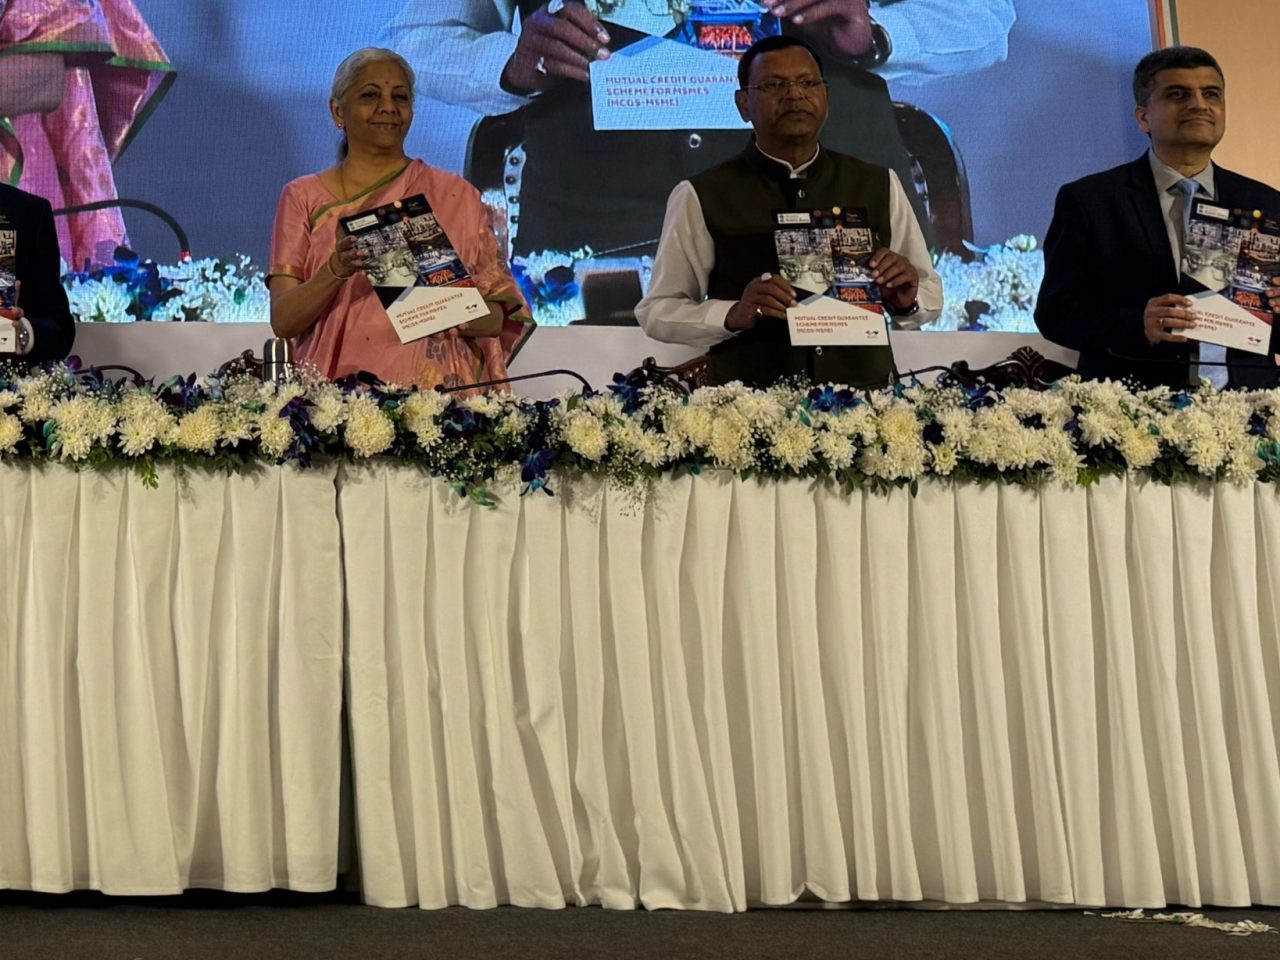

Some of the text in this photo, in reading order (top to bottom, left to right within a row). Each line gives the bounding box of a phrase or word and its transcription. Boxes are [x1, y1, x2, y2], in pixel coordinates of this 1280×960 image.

[606, 76, 647, 85] MUTUAL
[650, 75, 687, 84] CREDIT
[607, 87, 709, 96] SCHEME FOR MSMES
